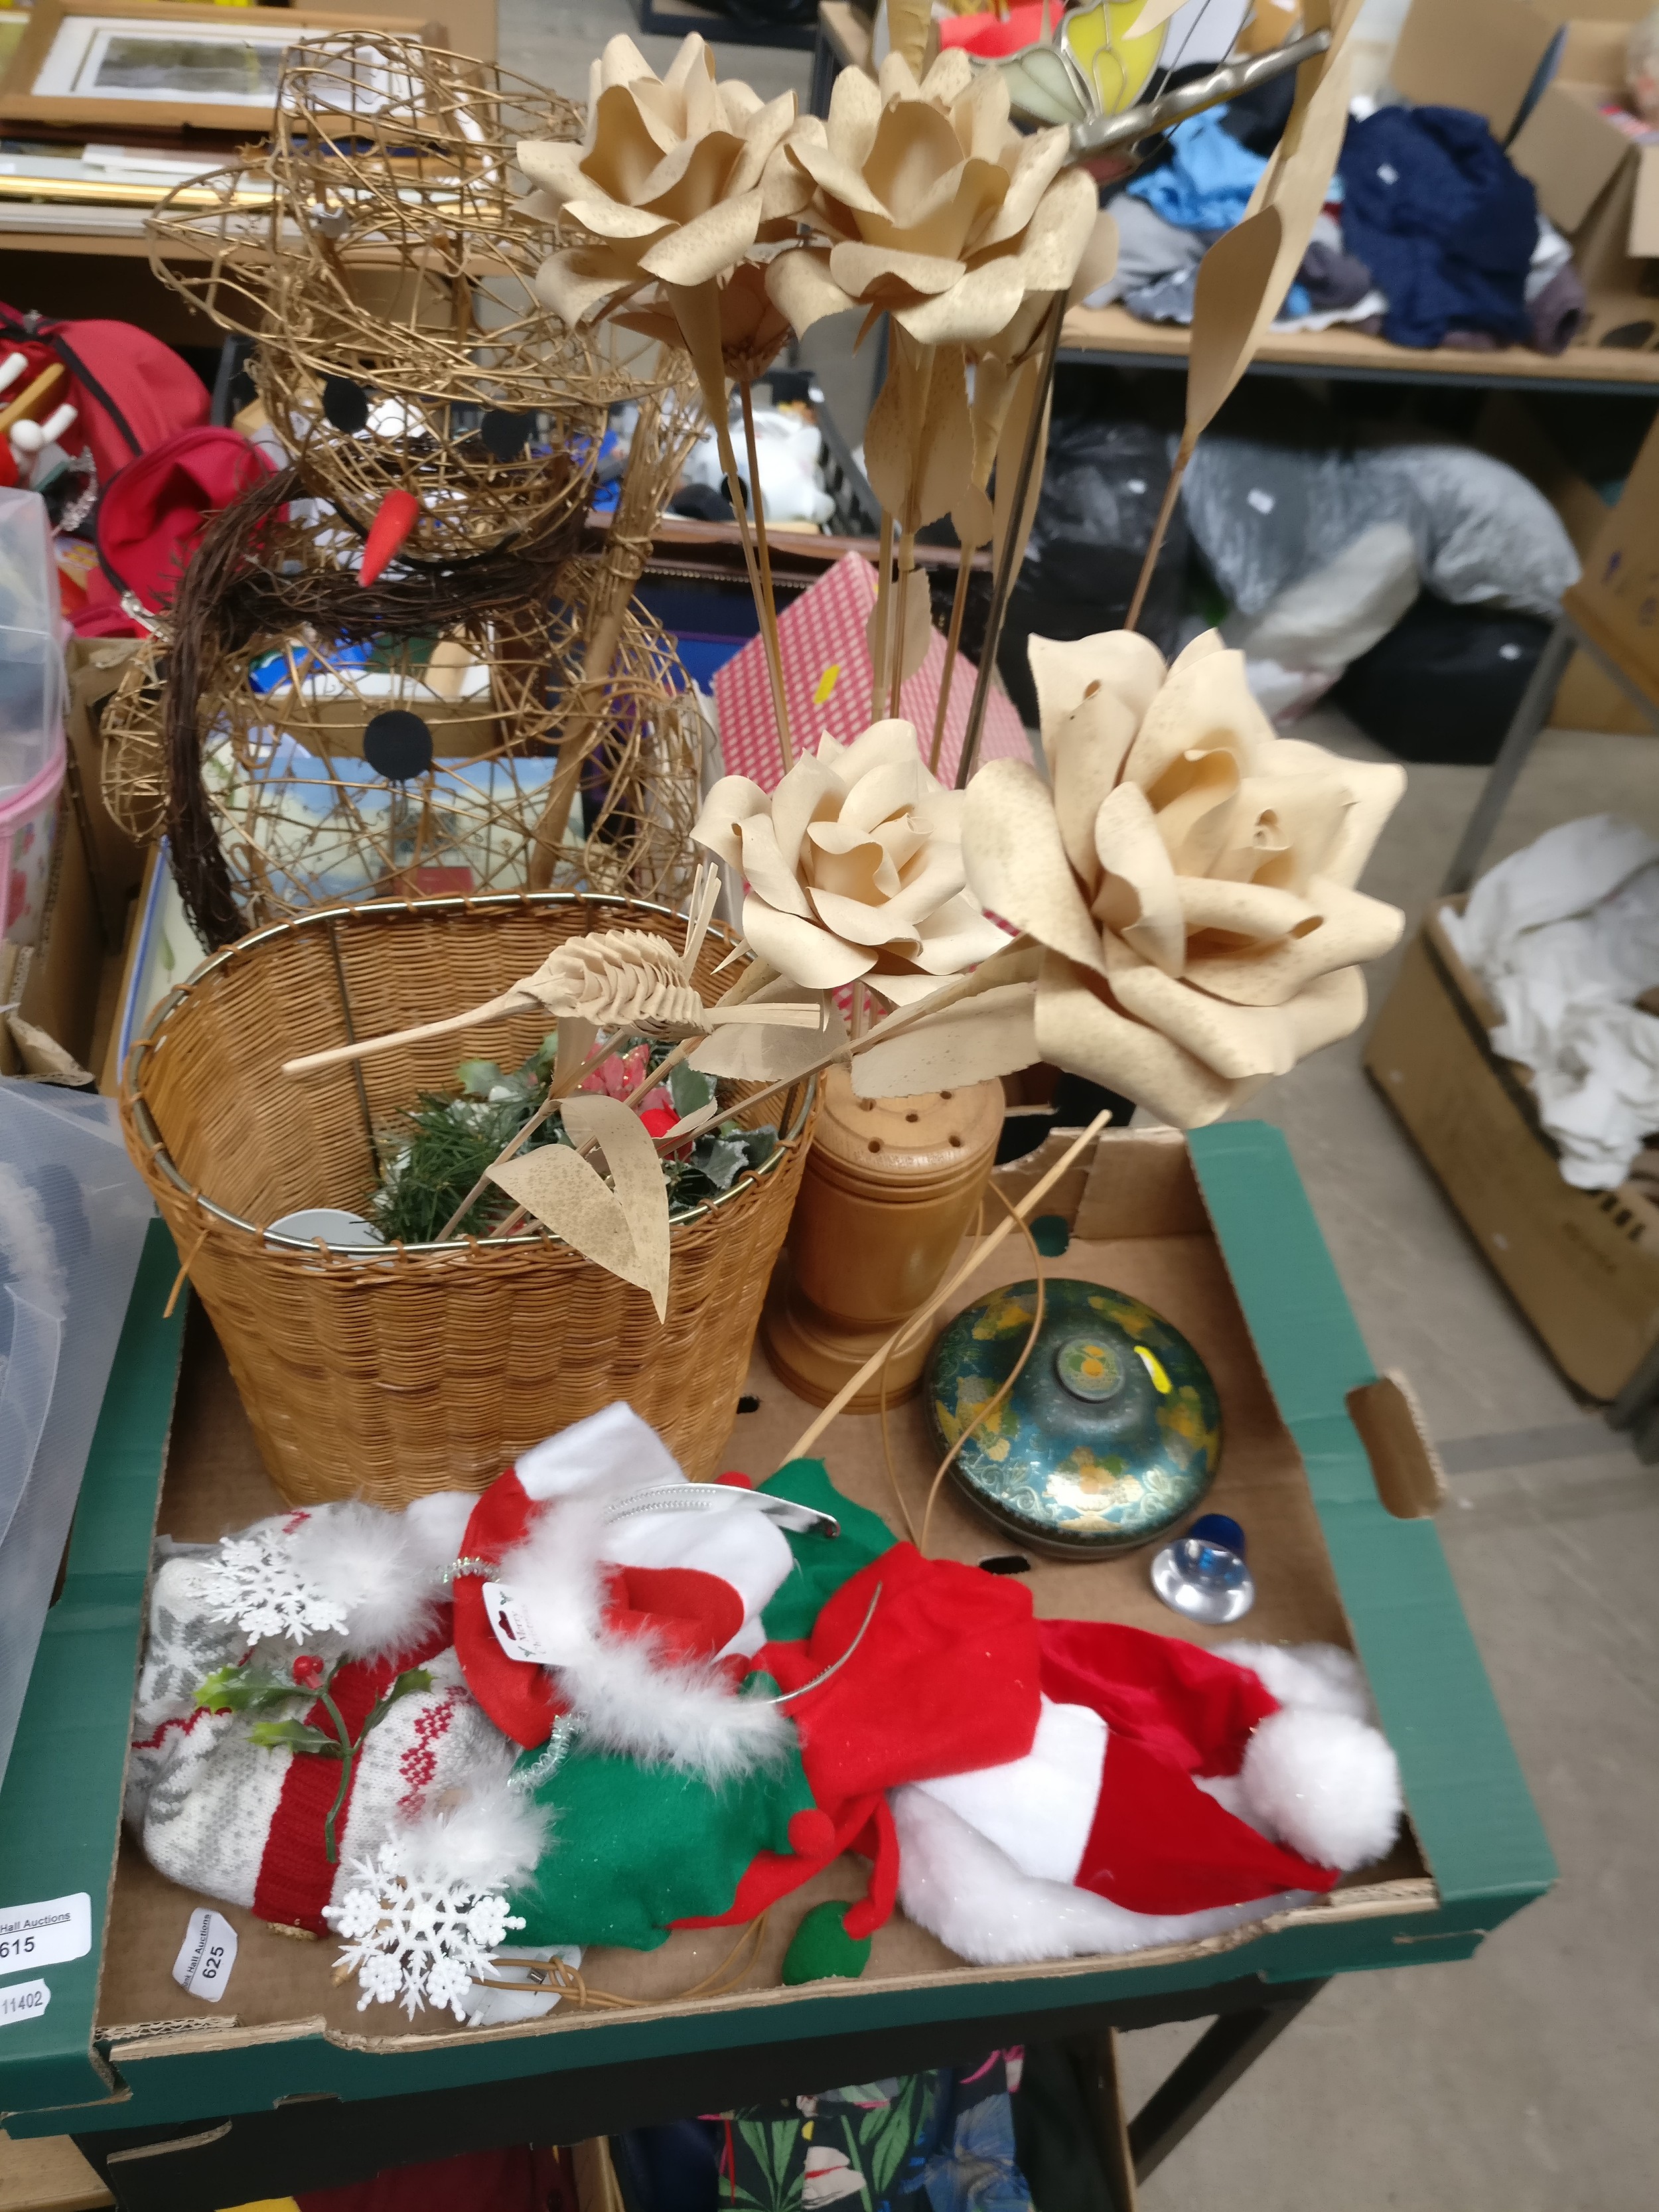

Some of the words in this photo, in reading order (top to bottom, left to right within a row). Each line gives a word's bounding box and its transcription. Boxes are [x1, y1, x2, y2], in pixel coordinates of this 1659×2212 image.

[1, 1921, 21, 1933] Hall
[23, 1912, 71, 1929] Auctions
[0, 1936, 35, 1958] 615
[187, 1956, 199, 1972] Hall
[195, 1914, 210, 1954] Auctions
[202, 1947, 224, 1978] 625
[2, 1991, 43, 2014] 11402
